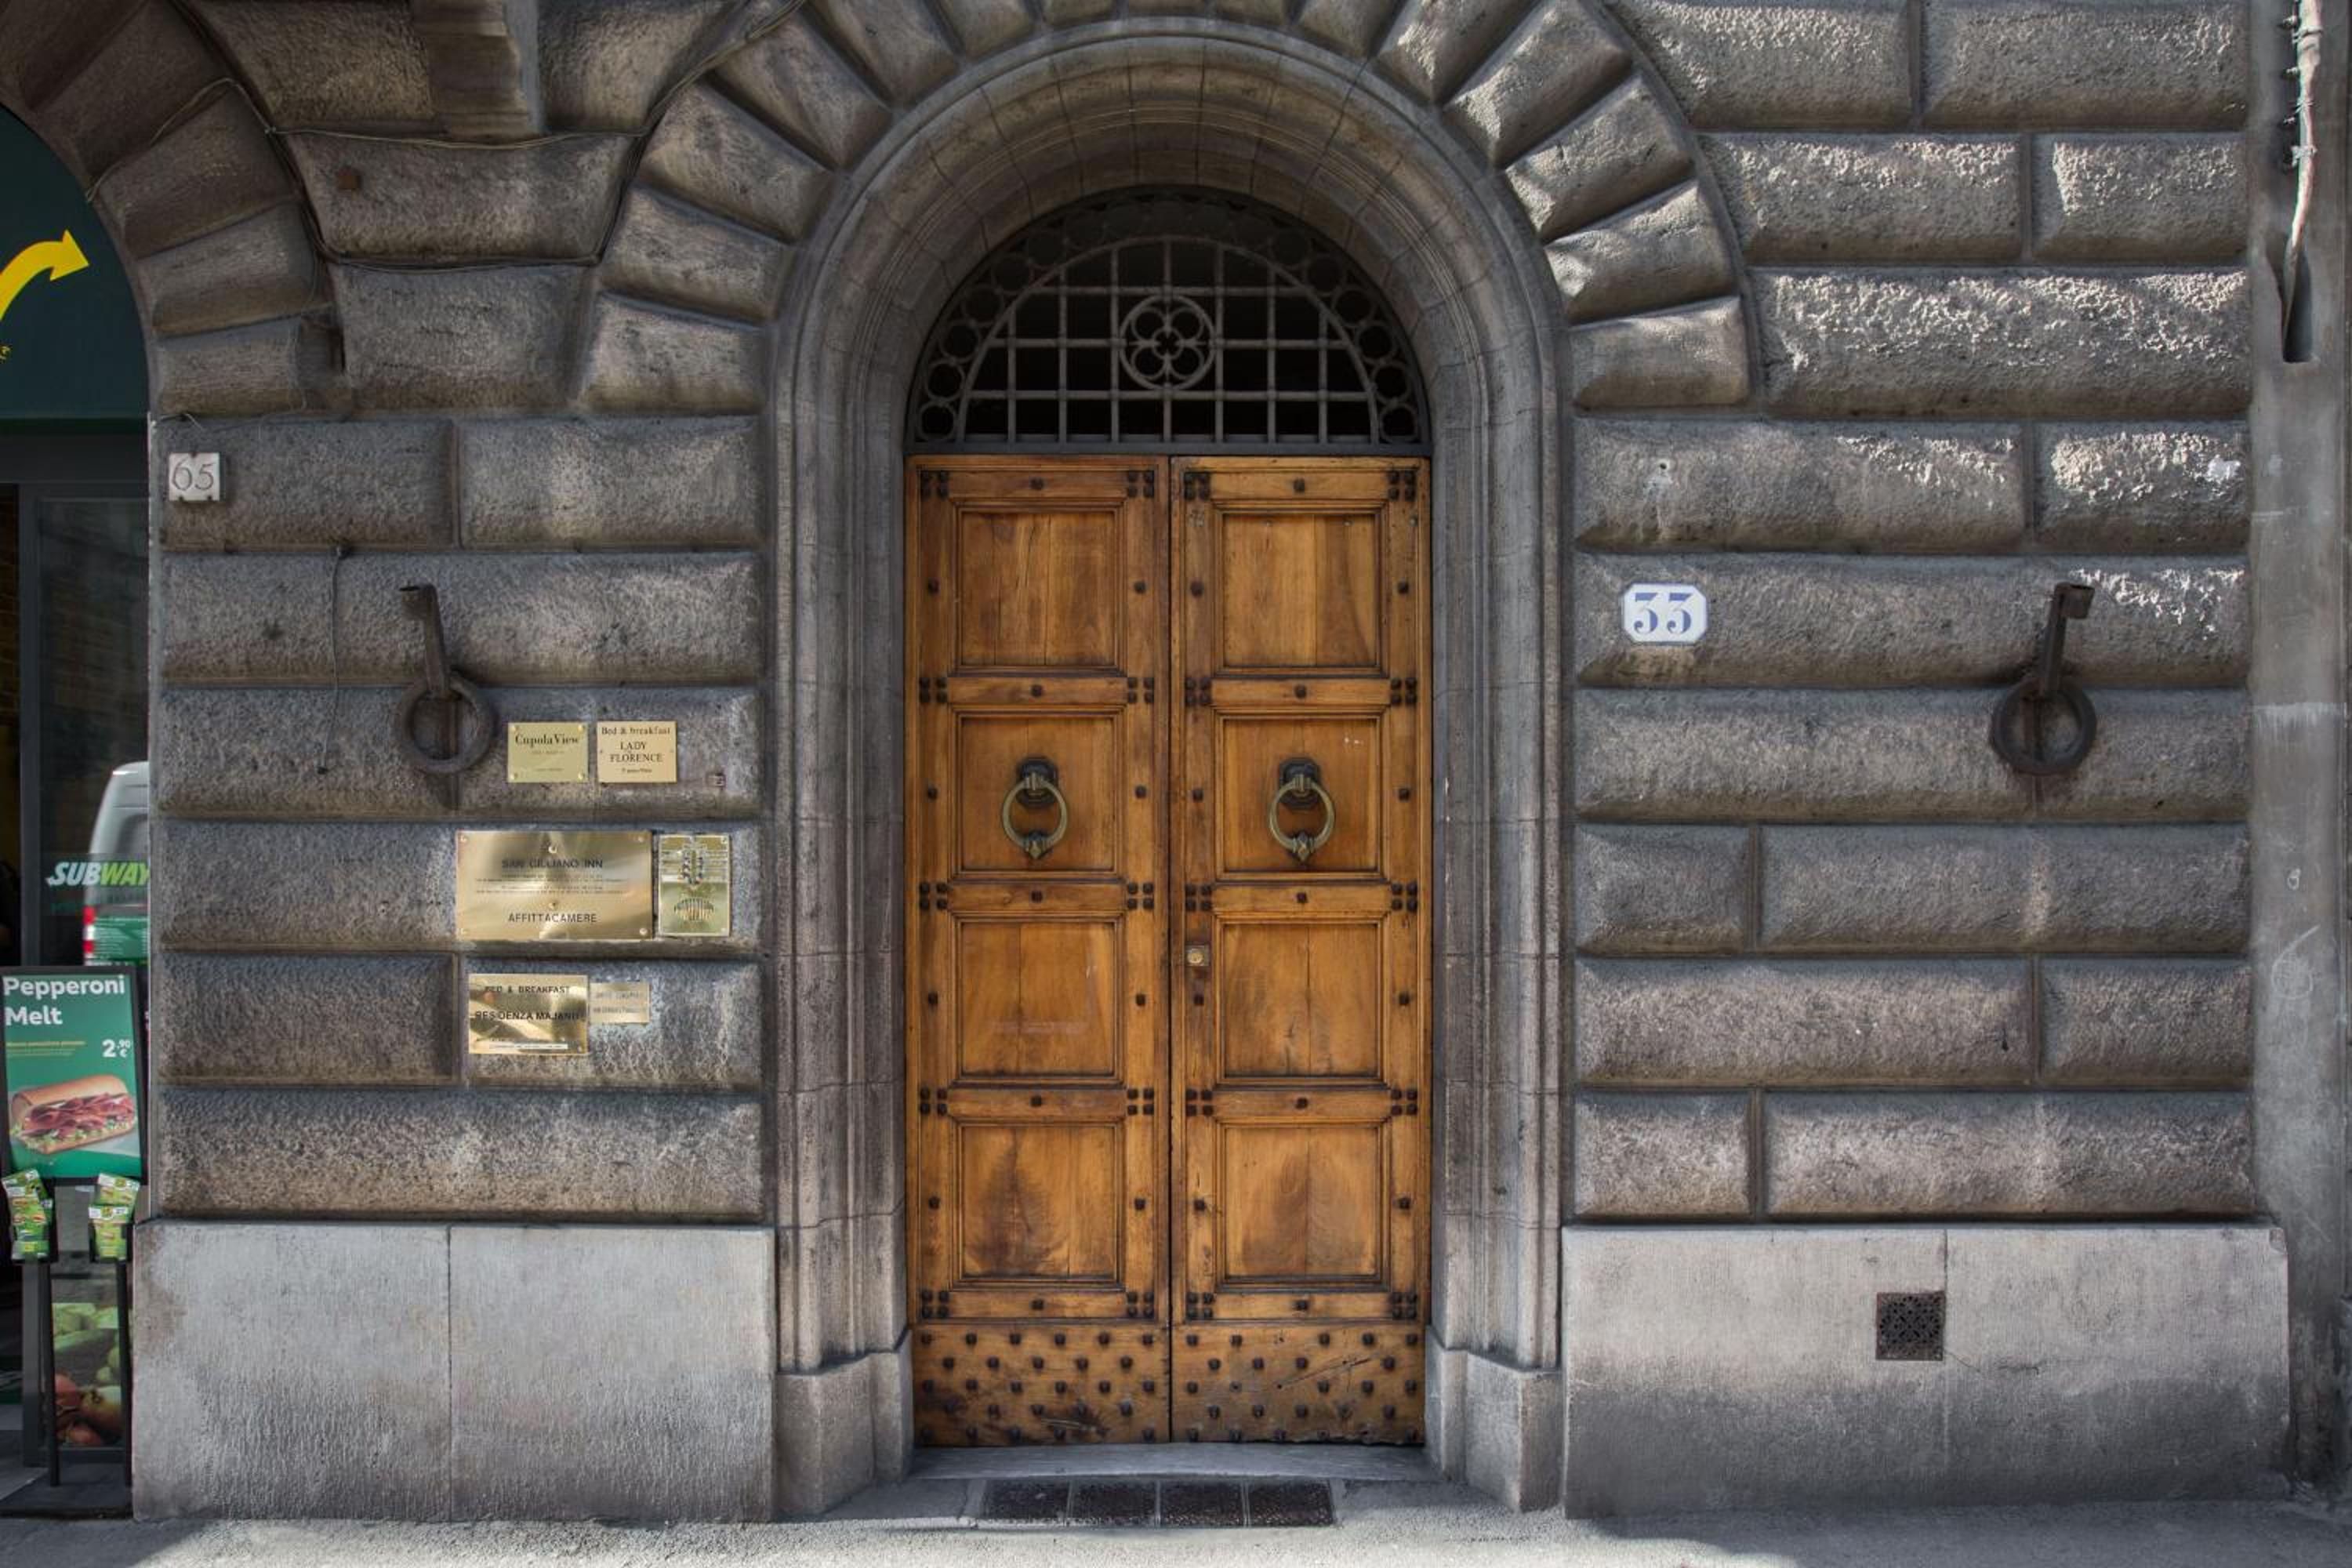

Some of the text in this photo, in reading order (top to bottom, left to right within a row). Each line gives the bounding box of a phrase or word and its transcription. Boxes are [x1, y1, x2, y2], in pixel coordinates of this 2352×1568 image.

[172, 457, 216, 492] 65
[1633, 592, 1693, 634] 33
[601, 727, 617, 735] Bed
[515, 733, 579, 748] Cupola View
[618, 741, 647, 750] LADY
[610, 753, 664, 763] FLORENCE
[584, 858, 603, 868] INN
[45, 862, 150, 887] SUBWAY
[508, 913, 597, 923] AFFITTACAMERE
[2, 975, 125, 1000] Pepperoni
[5, 1005, 63, 1025] Melt
